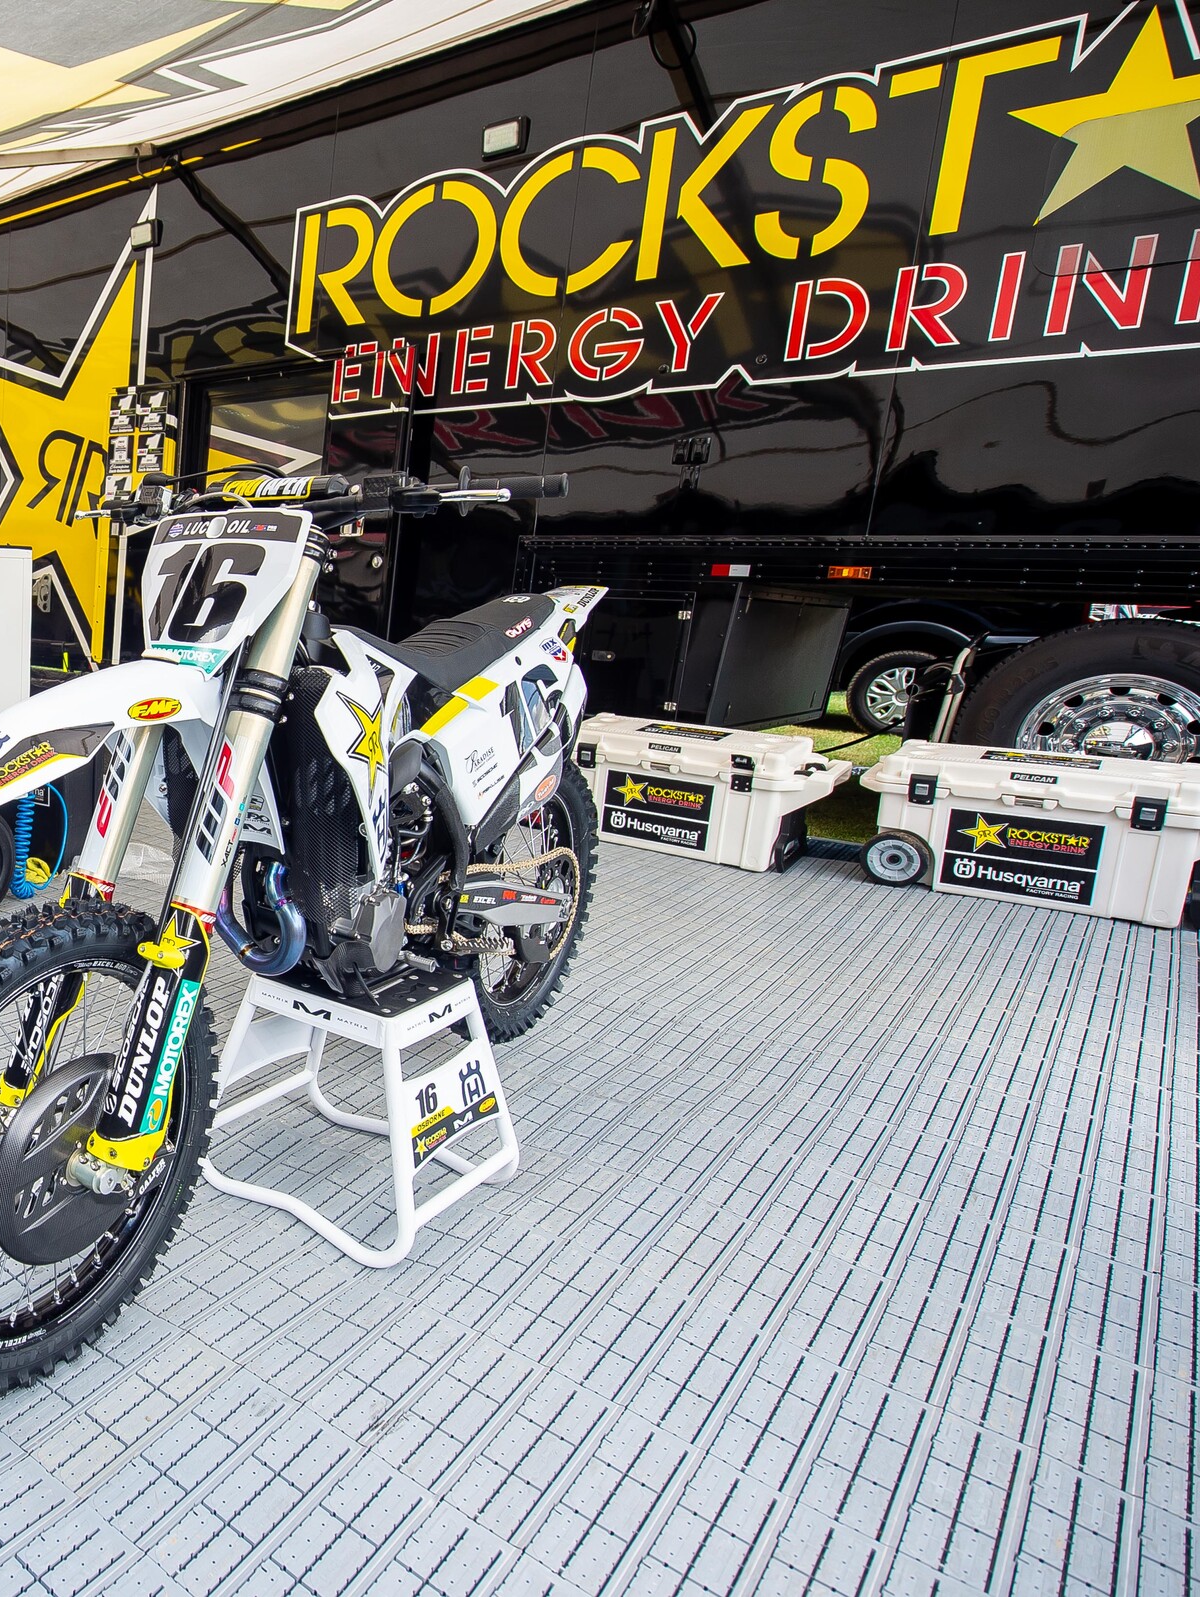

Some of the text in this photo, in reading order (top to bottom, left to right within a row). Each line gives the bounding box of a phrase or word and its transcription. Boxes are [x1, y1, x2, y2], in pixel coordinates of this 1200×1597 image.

[331, 291, 725, 404] ENERGY
[226, 520, 251, 534] OIL
[148, 542, 266, 643] 16
[505, 617, 533, 638] GUTS
[129, 699, 181, 719] FMF
[650, 744, 679, 752] PELICAN
[30, 750, 58, 767] DRINK
[1013, 773, 1054, 783] PELICAN
[647, 786, 705, 804] ROCKSTAR
[648, 795, 701, 809] ENERGY DRINK
[627, 817, 699, 840] Husqvarna
[1007, 828, 1090, 848] ROCKSTAR
[221, 839, 234, 867] XACT
[1009, 838, 1086, 854] ENERGY DRINK
[977, 865, 1081, 893] Husqvarna
[473, 895, 496, 905] EXCEL
[1026, 888, 1079, 900] FACTORY RACING
[92, 960, 114, 968] EXCEL
[261, 991, 289, 1004] MATRIX
[337, 1016, 369, 1031] MATRIX
[406, 1019, 427, 1031] MATRIX
[118, 976, 167, 1128] DUNLOP
[153, 988, 197, 1097] MOTOREX
[415, 1082, 438, 1119] 16
[417, 1109, 446, 1132] OSBORNE
[5, 1334, 27, 1346] EXCEL
